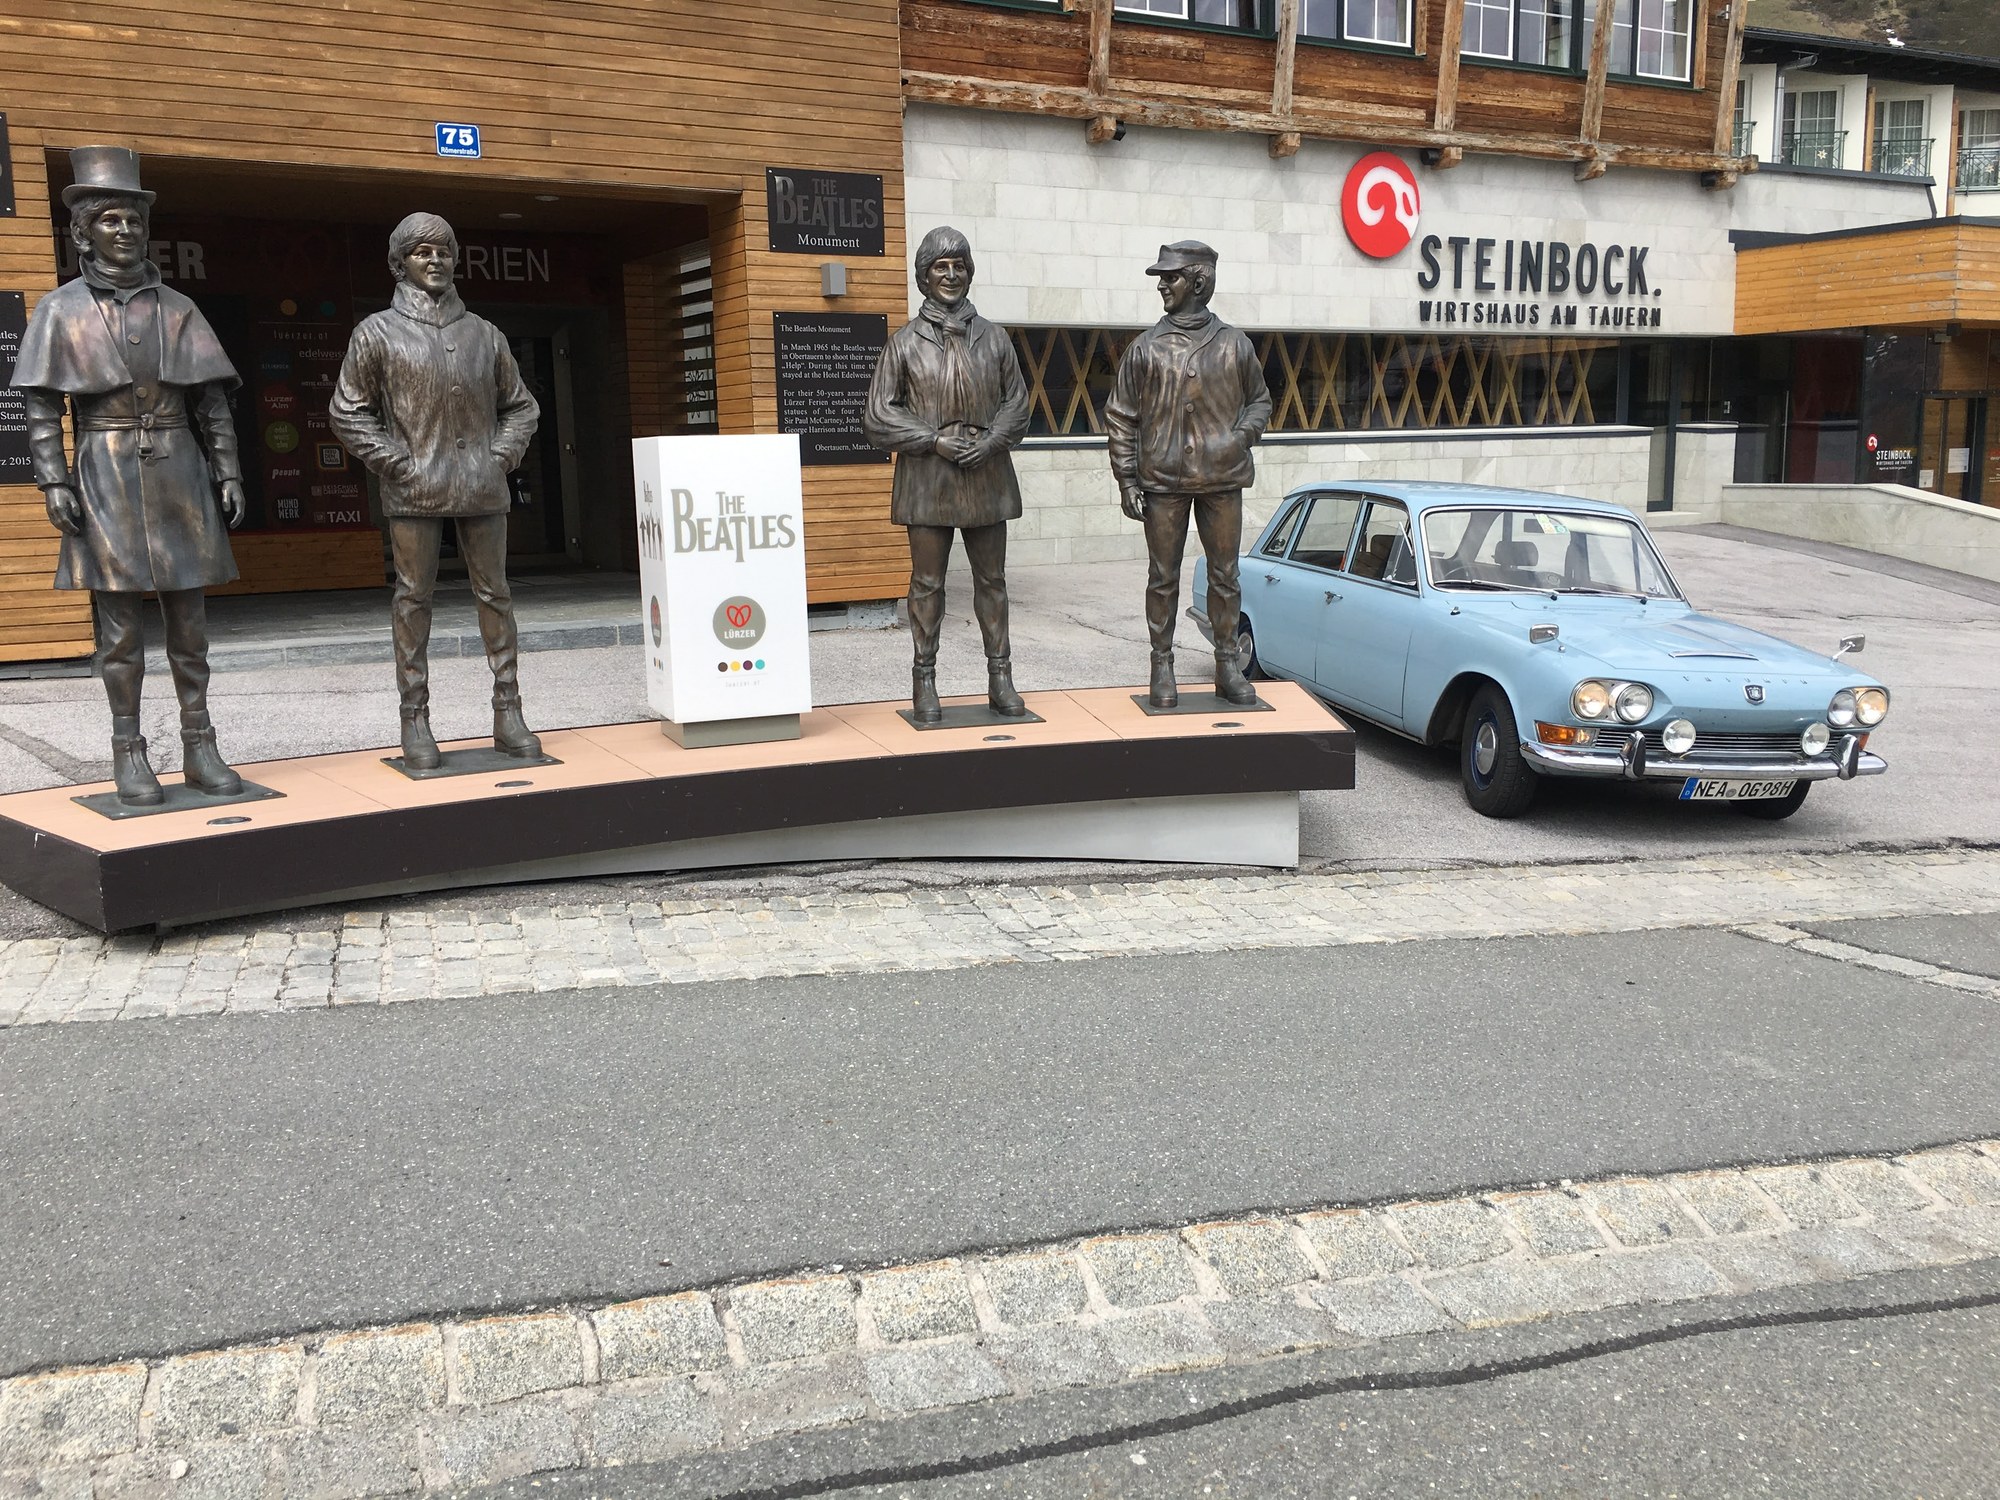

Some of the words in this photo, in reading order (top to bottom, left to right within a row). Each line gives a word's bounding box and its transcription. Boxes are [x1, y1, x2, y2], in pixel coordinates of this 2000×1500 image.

[442, 128, 474, 146] 75
[441, 147, 477, 155] Römerstraße
[812, 178, 837, 195] THE
[798, 234, 860, 248] Monument
[1417, 234, 1662, 296] STEINBOCK.
[1419, 300, 1539, 325] WIRTSHAUS
[1551, 305, 1577, 325] AM
[1588, 305, 1661, 327] TAUERN
[794, 325, 817, 333] Beatles
[0, 330, 18, 339] tles
[781, 343, 788, 351] In
[790, 343, 811, 351] March
[843, 344, 865, 352] Beatles
[789, 352, 824, 360] Obertauern
[849, 353, 864, 361] their
[808, 362, 832, 371] During
[835, 362, 848, 370] this
[851, 362, 866, 370] time
[782, 371, 803, 380] stayed
[811, 371, 821, 379] the
[823, 371, 840, 379] Hotel
[0, 388, 24, 398] nden,
[797, 389, 813, 397] their
[816, 389, 845, 398] 50-years
[831, 398, 866, 406] established
[812, 407, 820, 415] of
[841, 407, 855, 415] four
[0, 411, 27, 421] Starr,
[784, 417, 793, 425] Sir
[809, 417, 845, 425] McCartney,
[846, 416, 860, 424] John
[784, 426, 807, 434] George
[849, 426, 864, 434] Ring
[9, 457, 31, 465] 2015
[715, 491, 746, 516] THE
[278, 509, 300, 519] WERK
[327, 511, 360, 523] TAXI
[670, 489, 796, 562] BEATLES
[724, 629, 756, 639] LÜRZER
[1693, 781, 1728, 797] NEA
